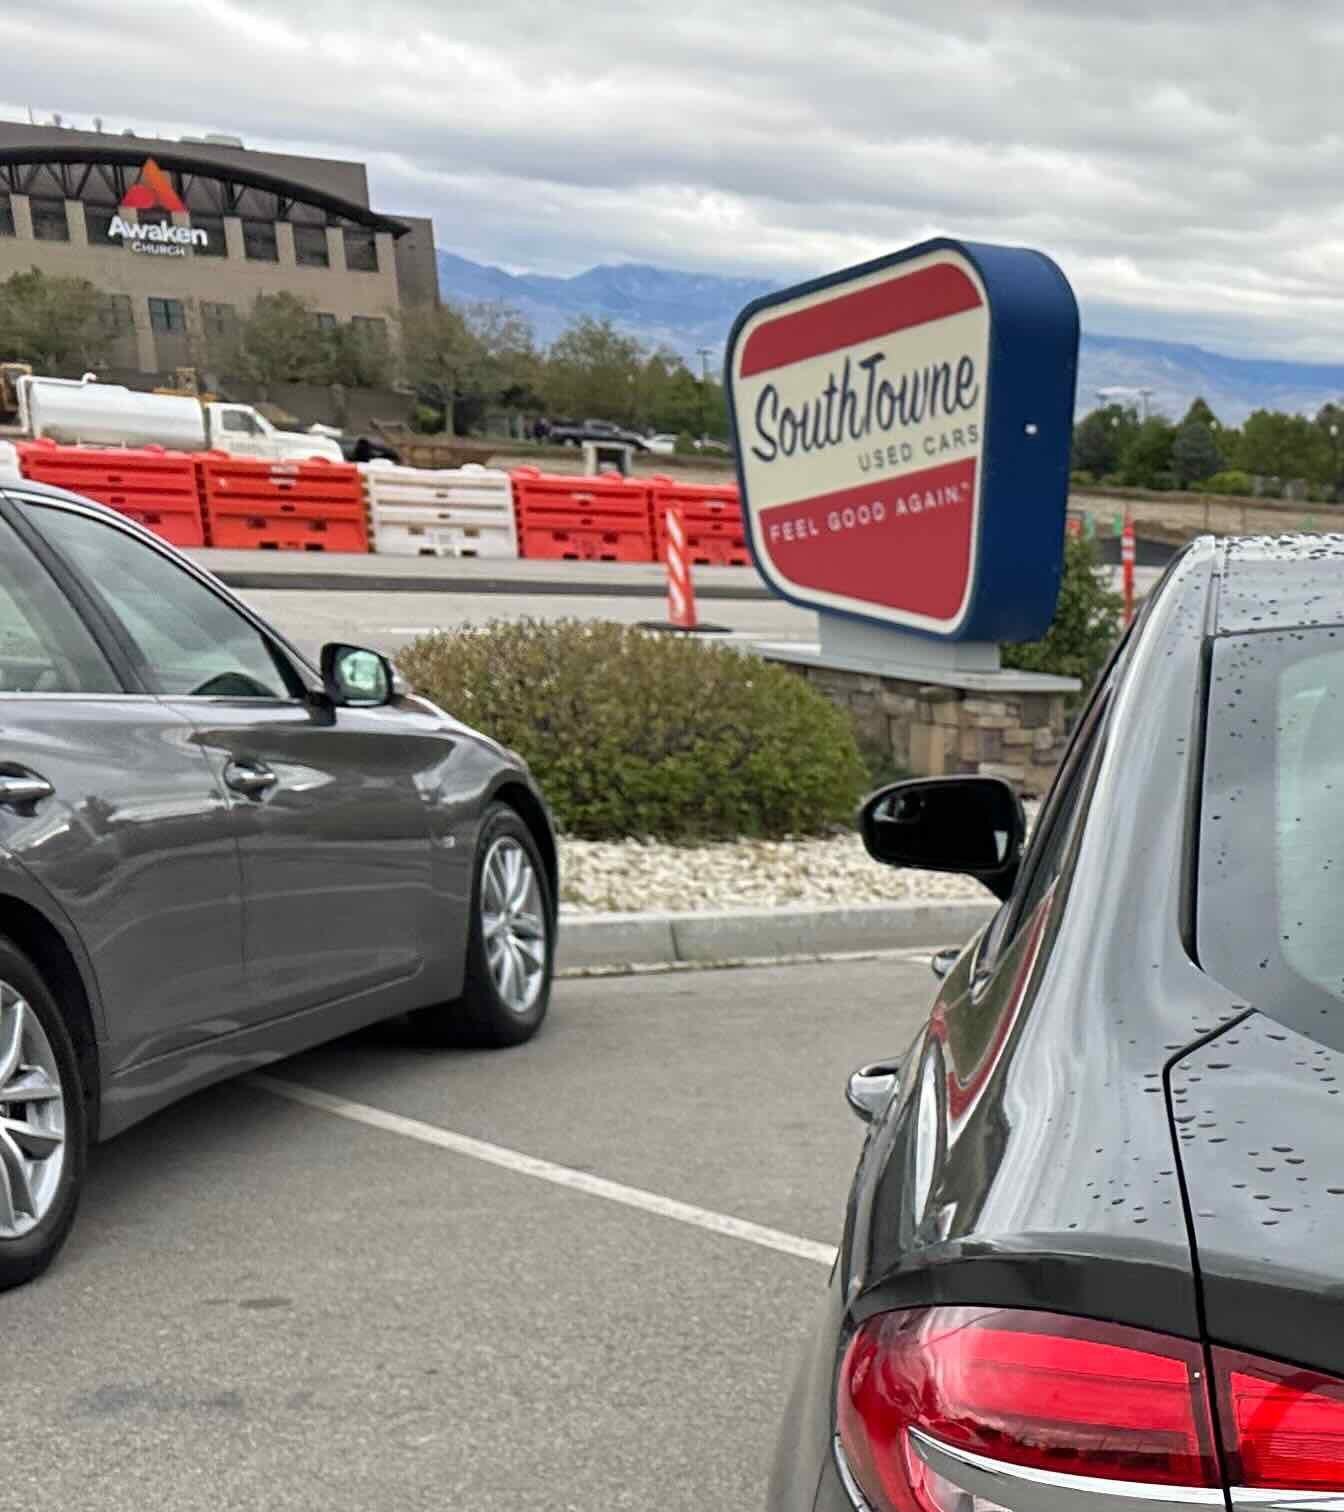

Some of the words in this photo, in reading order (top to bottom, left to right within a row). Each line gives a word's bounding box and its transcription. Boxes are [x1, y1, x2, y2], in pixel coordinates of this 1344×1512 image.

[108, 215, 208, 247] Awaken
[132, 241, 185, 256] CHURCH
[752, 352, 979, 462] SouthTowne
[858, 443, 912, 472] USED
[923, 424, 979, 456] CARS
[769, 518, 819, 544] FEEL
[827, 501, 886, 532] GOOD
